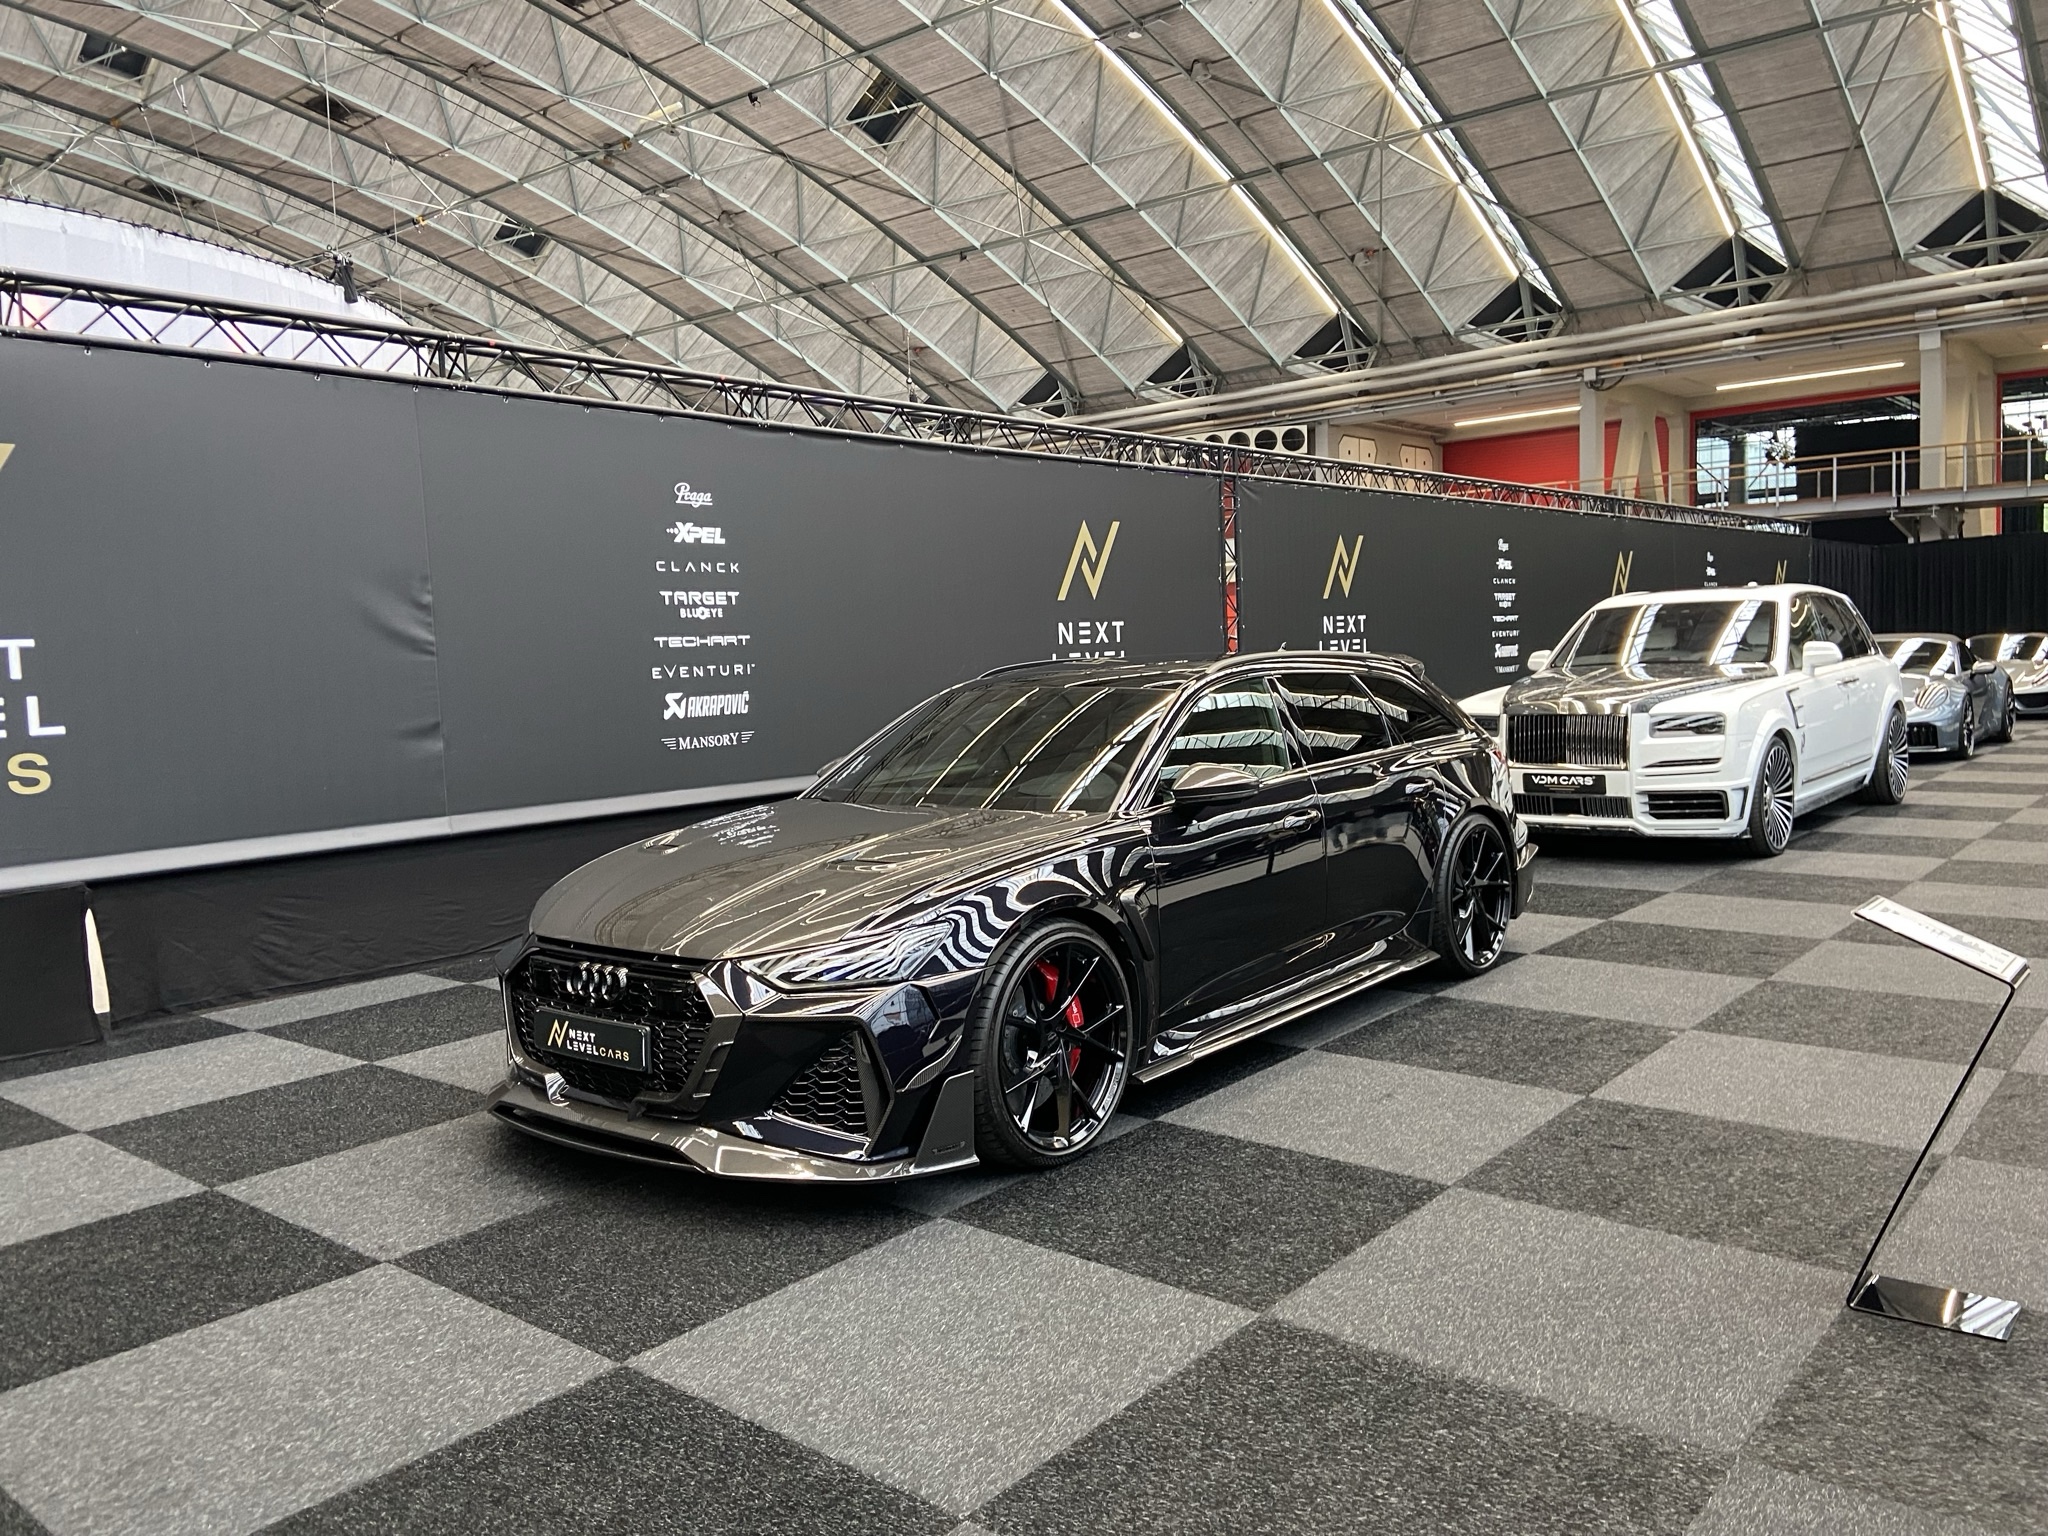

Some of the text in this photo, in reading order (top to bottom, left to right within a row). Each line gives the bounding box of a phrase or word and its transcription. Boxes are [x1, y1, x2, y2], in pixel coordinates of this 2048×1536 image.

[674, 483, 713, 508] Praga
[673, 522, 726, 545] XPEL
[655, 560, 740, 574] CLANCK
[659, 591, 740, 606] TARGET
[1057, 621, 1125, 645] NEXT
[1323, 615, 1367, 634] NEXT
[653, 634, 751, 649] TECHART
[678, 731, 740, 751] MANSORY
[1531, 775, 1594, 786] VDM CARS
[568, 1028, 596, 1043] NEXT
